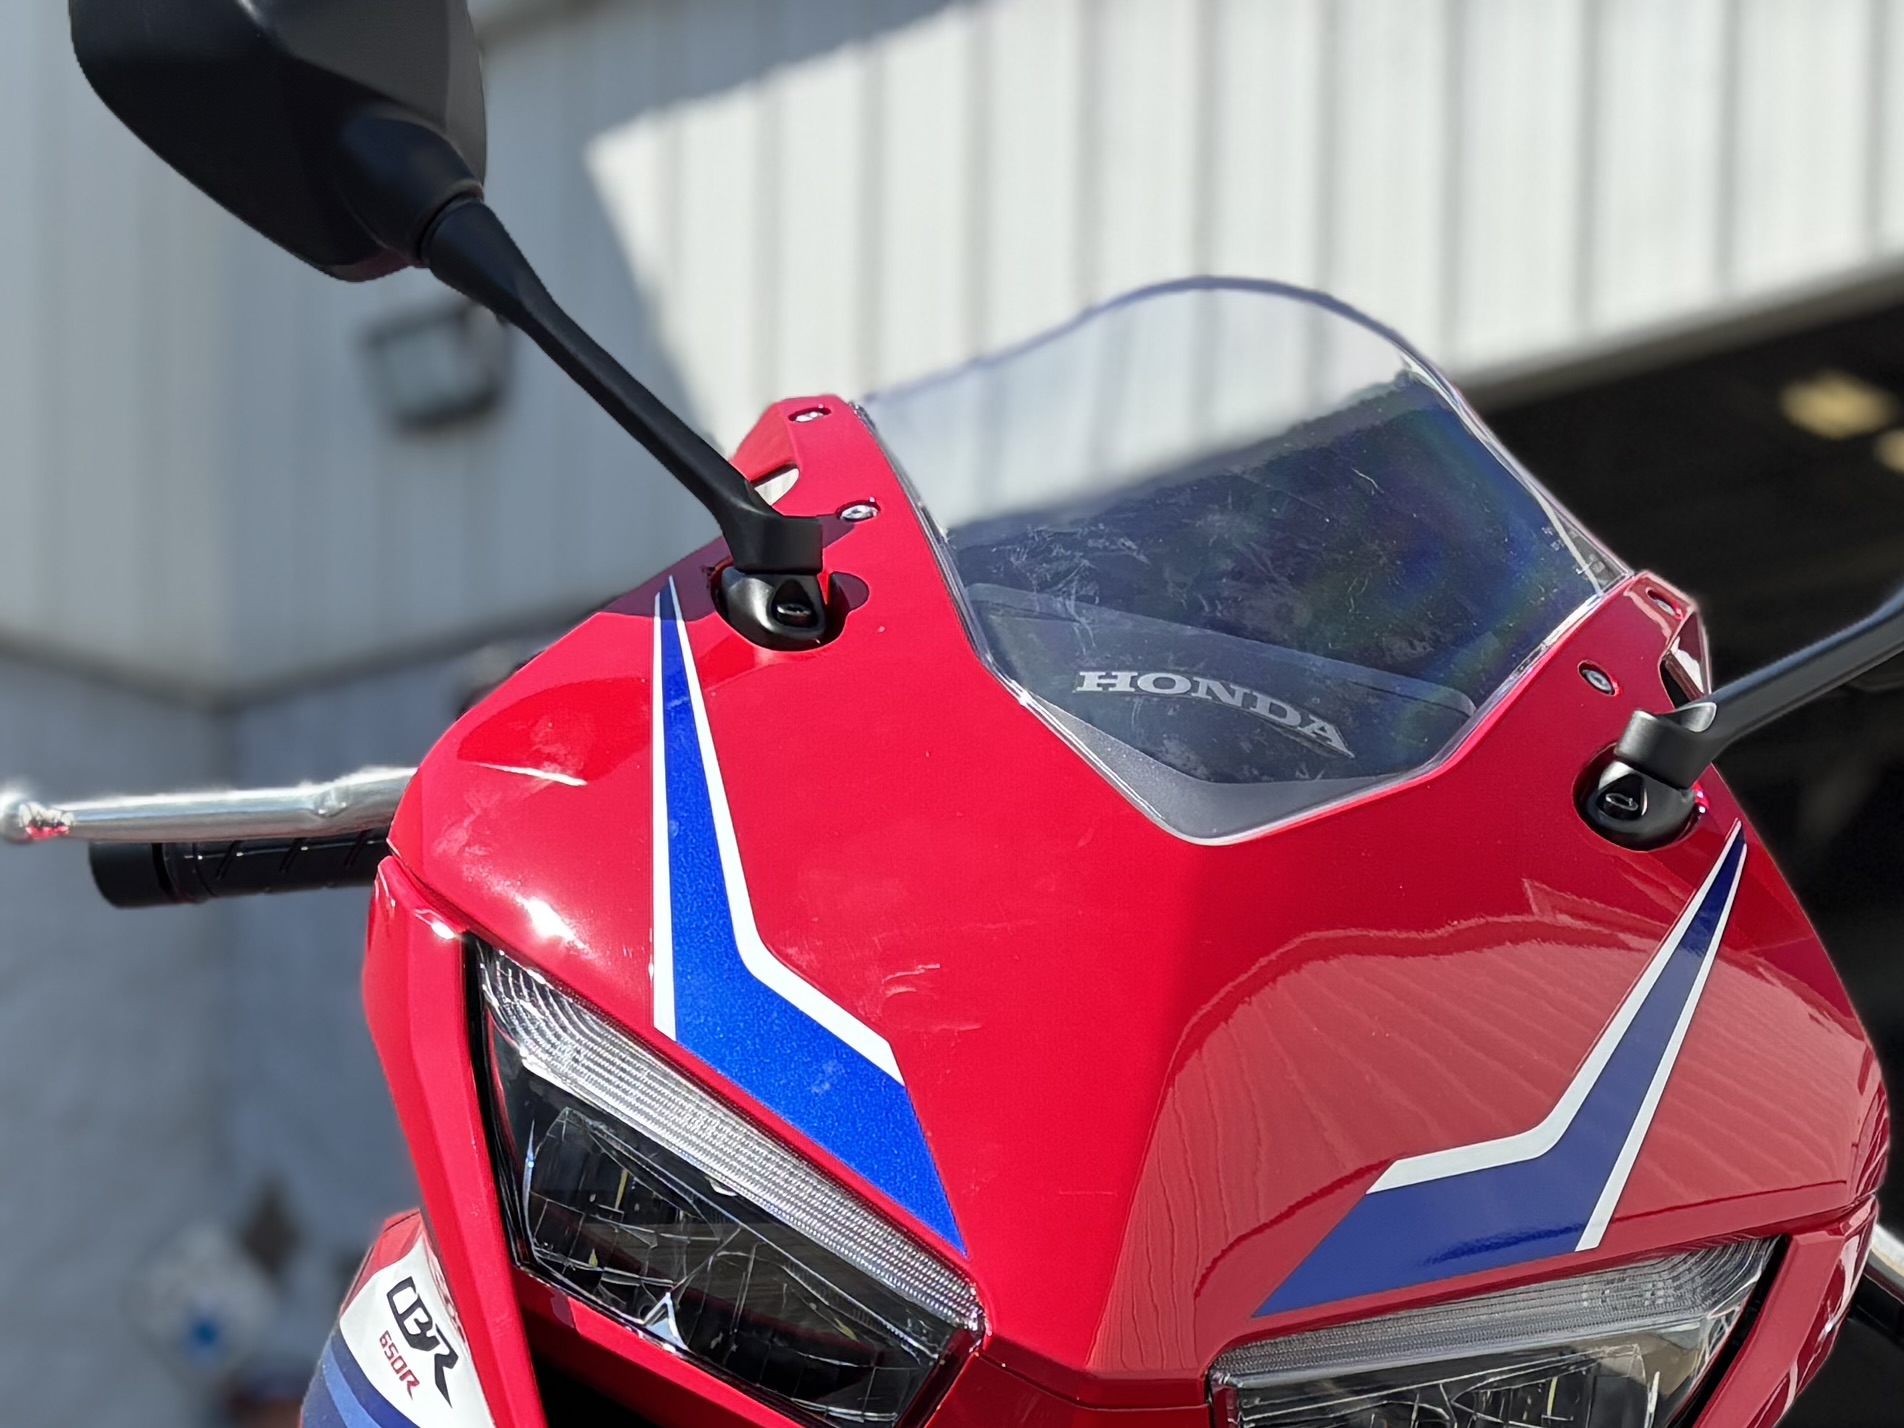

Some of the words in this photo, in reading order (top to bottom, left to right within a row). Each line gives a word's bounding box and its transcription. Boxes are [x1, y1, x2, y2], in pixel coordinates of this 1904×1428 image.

[1075, 671, 1354, 759] HONDA
[379, 1330, 421, 1400] 650R
[386, 1276, 459, 1409] CBR
